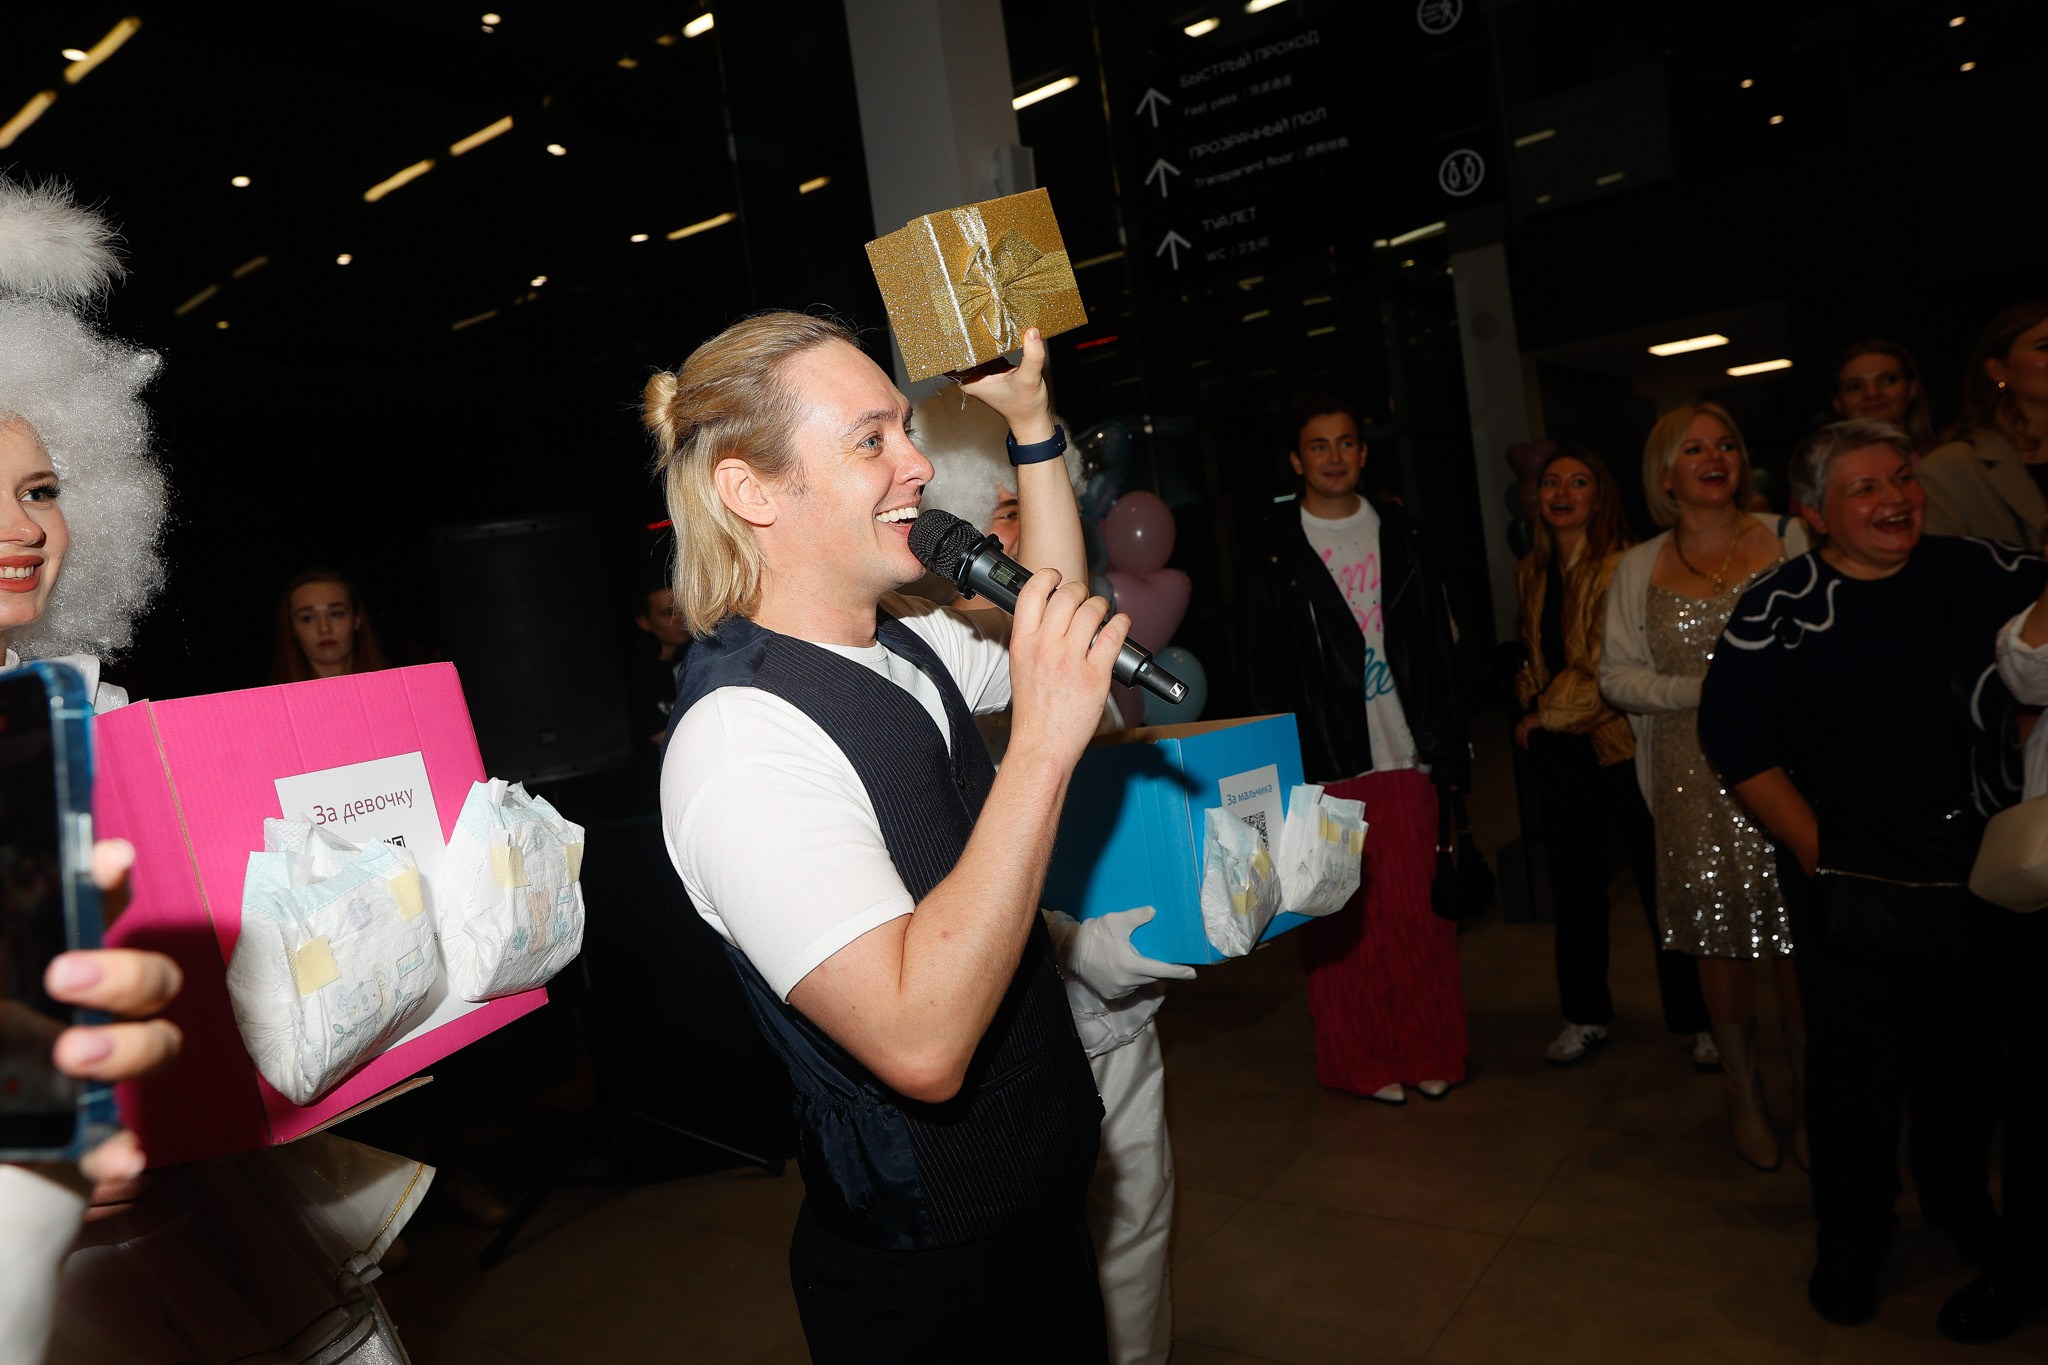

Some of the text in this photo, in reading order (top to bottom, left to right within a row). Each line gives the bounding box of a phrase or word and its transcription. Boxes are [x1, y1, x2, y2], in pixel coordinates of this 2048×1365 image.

[1179, 51, 1252, 89] БЫСТРЫЙ
[1254, 29, 1320, 63] ПРОХОД
[1292, 105, 1328, 129] ПОЛ
[1205, 247, 1227, 262] WC
[313, 788, 414, 825] За девочку
[1226, 784, 1273, 806] За мальчика
